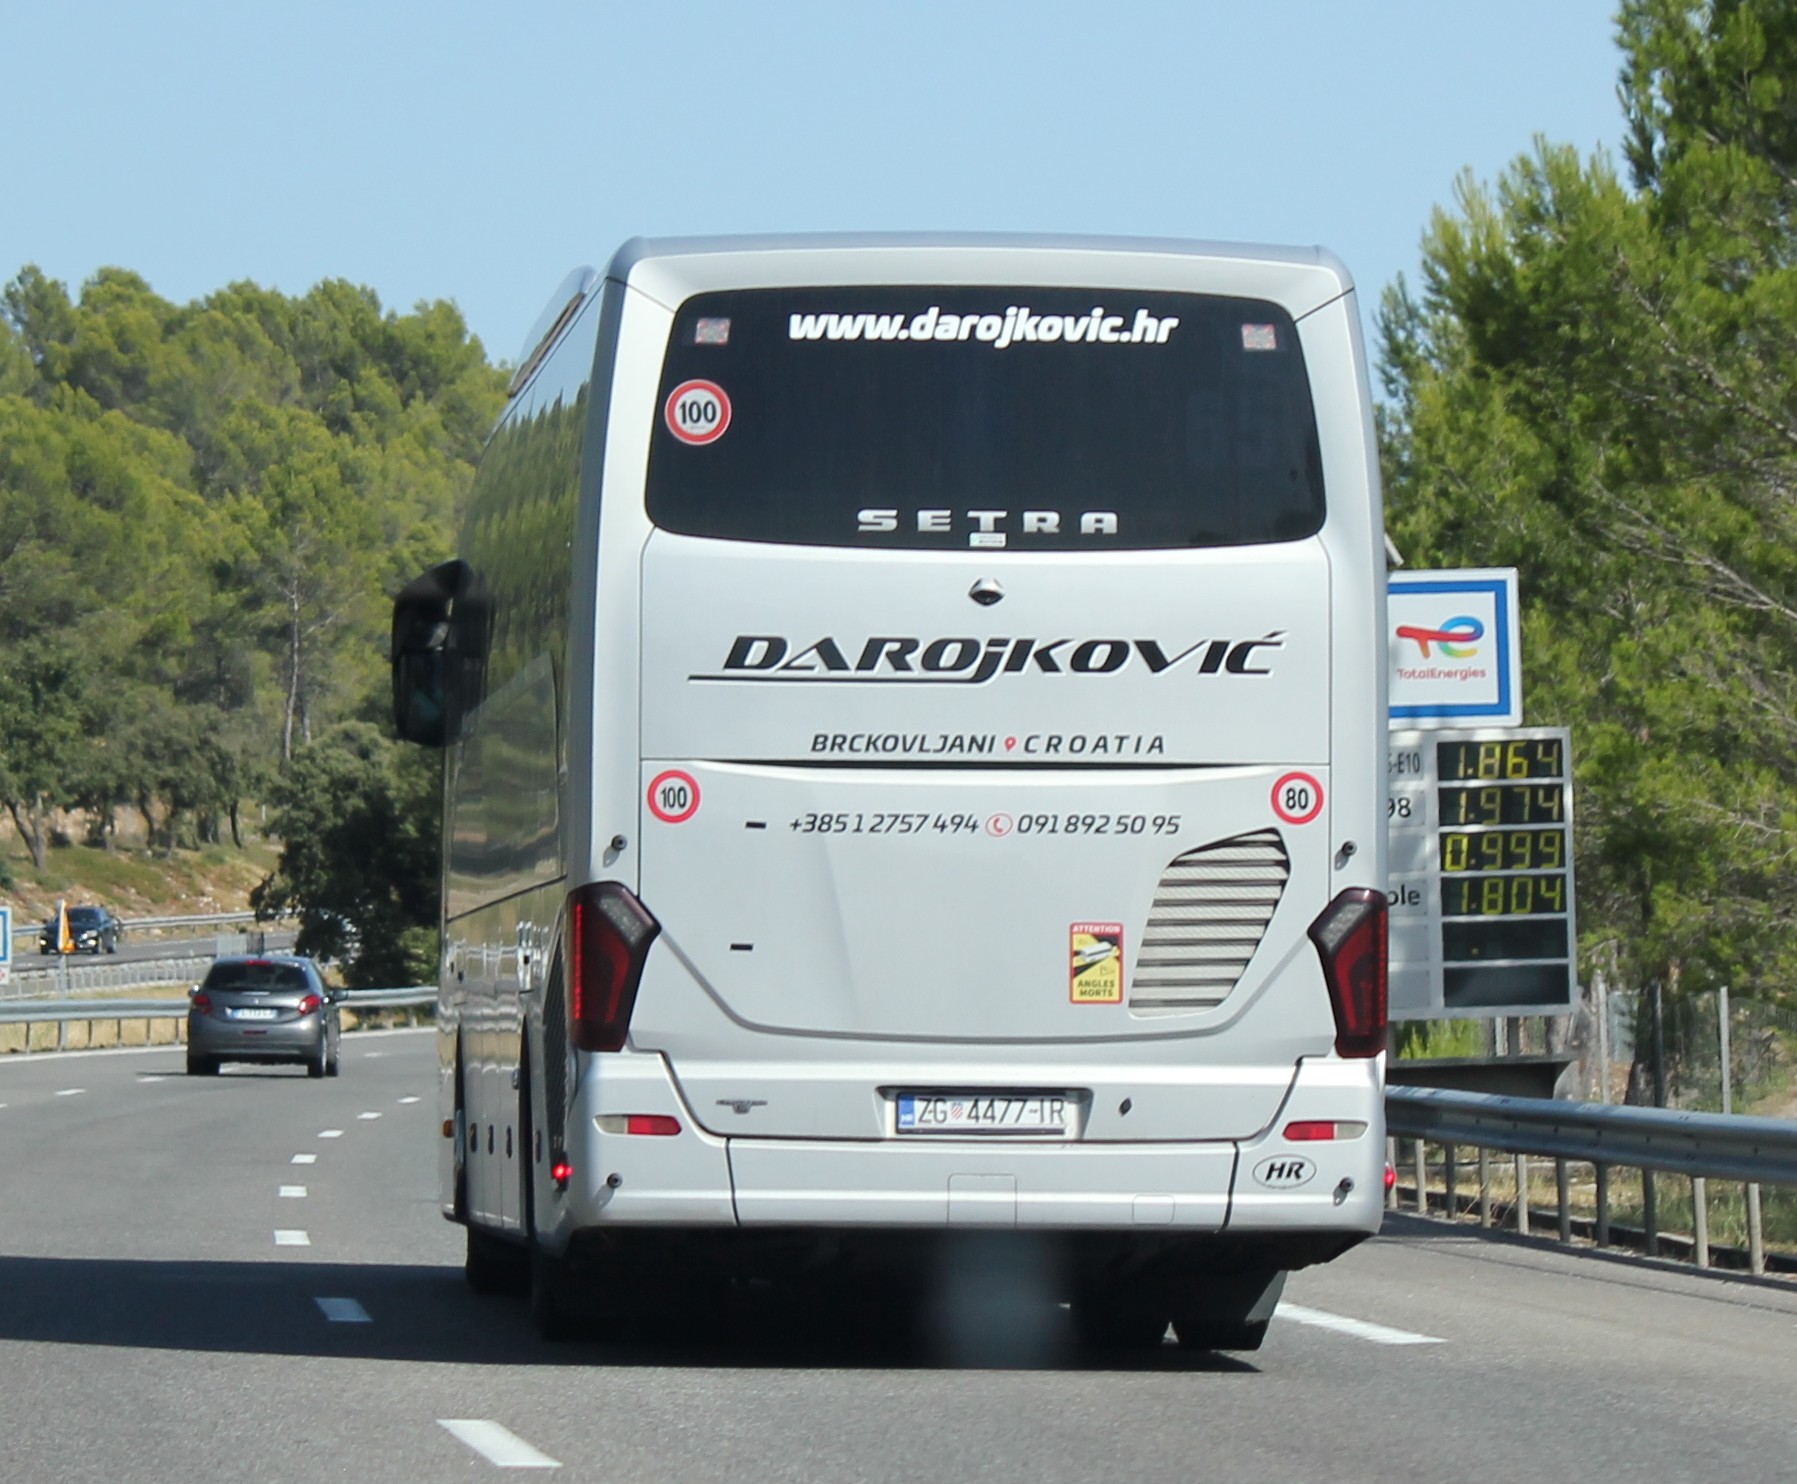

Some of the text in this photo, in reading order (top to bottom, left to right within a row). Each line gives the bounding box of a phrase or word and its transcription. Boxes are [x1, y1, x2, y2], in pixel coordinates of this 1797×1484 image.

[788, 306, 1179, 349] www.darojkovic.hr
[679, 400, 717, 425] 100
[857, 509, 1118, 535] SETRA
[1397, 667, 1486, 681] TotalEnergies
[810, 734, 1165, 754] BRCKOVLJANI CROATIA
[1458, 741, 1559, 779] 1.864
[661, 786, 687, 808] 100
[1286, 787, 1309, 810] 80
[1459, 787, 1560, 825] 1.974
[790, 813, 849, 833] +385
[869, 814, 930, 833] 2757
[932, 814, 979, 833] 494
[1445, 831, 1561, 871] 0.999
[1461, 877, 1562, 915] 1.804
[1073, 925, 1120, 933] ATTENTION
[1078, 980, 1115, 988] ANGLES
[1080, 989, 1113, 997] MORTS
[918, 1098, 947, 1124] ZG
[1265, 1161, 1305, 1181] HR
